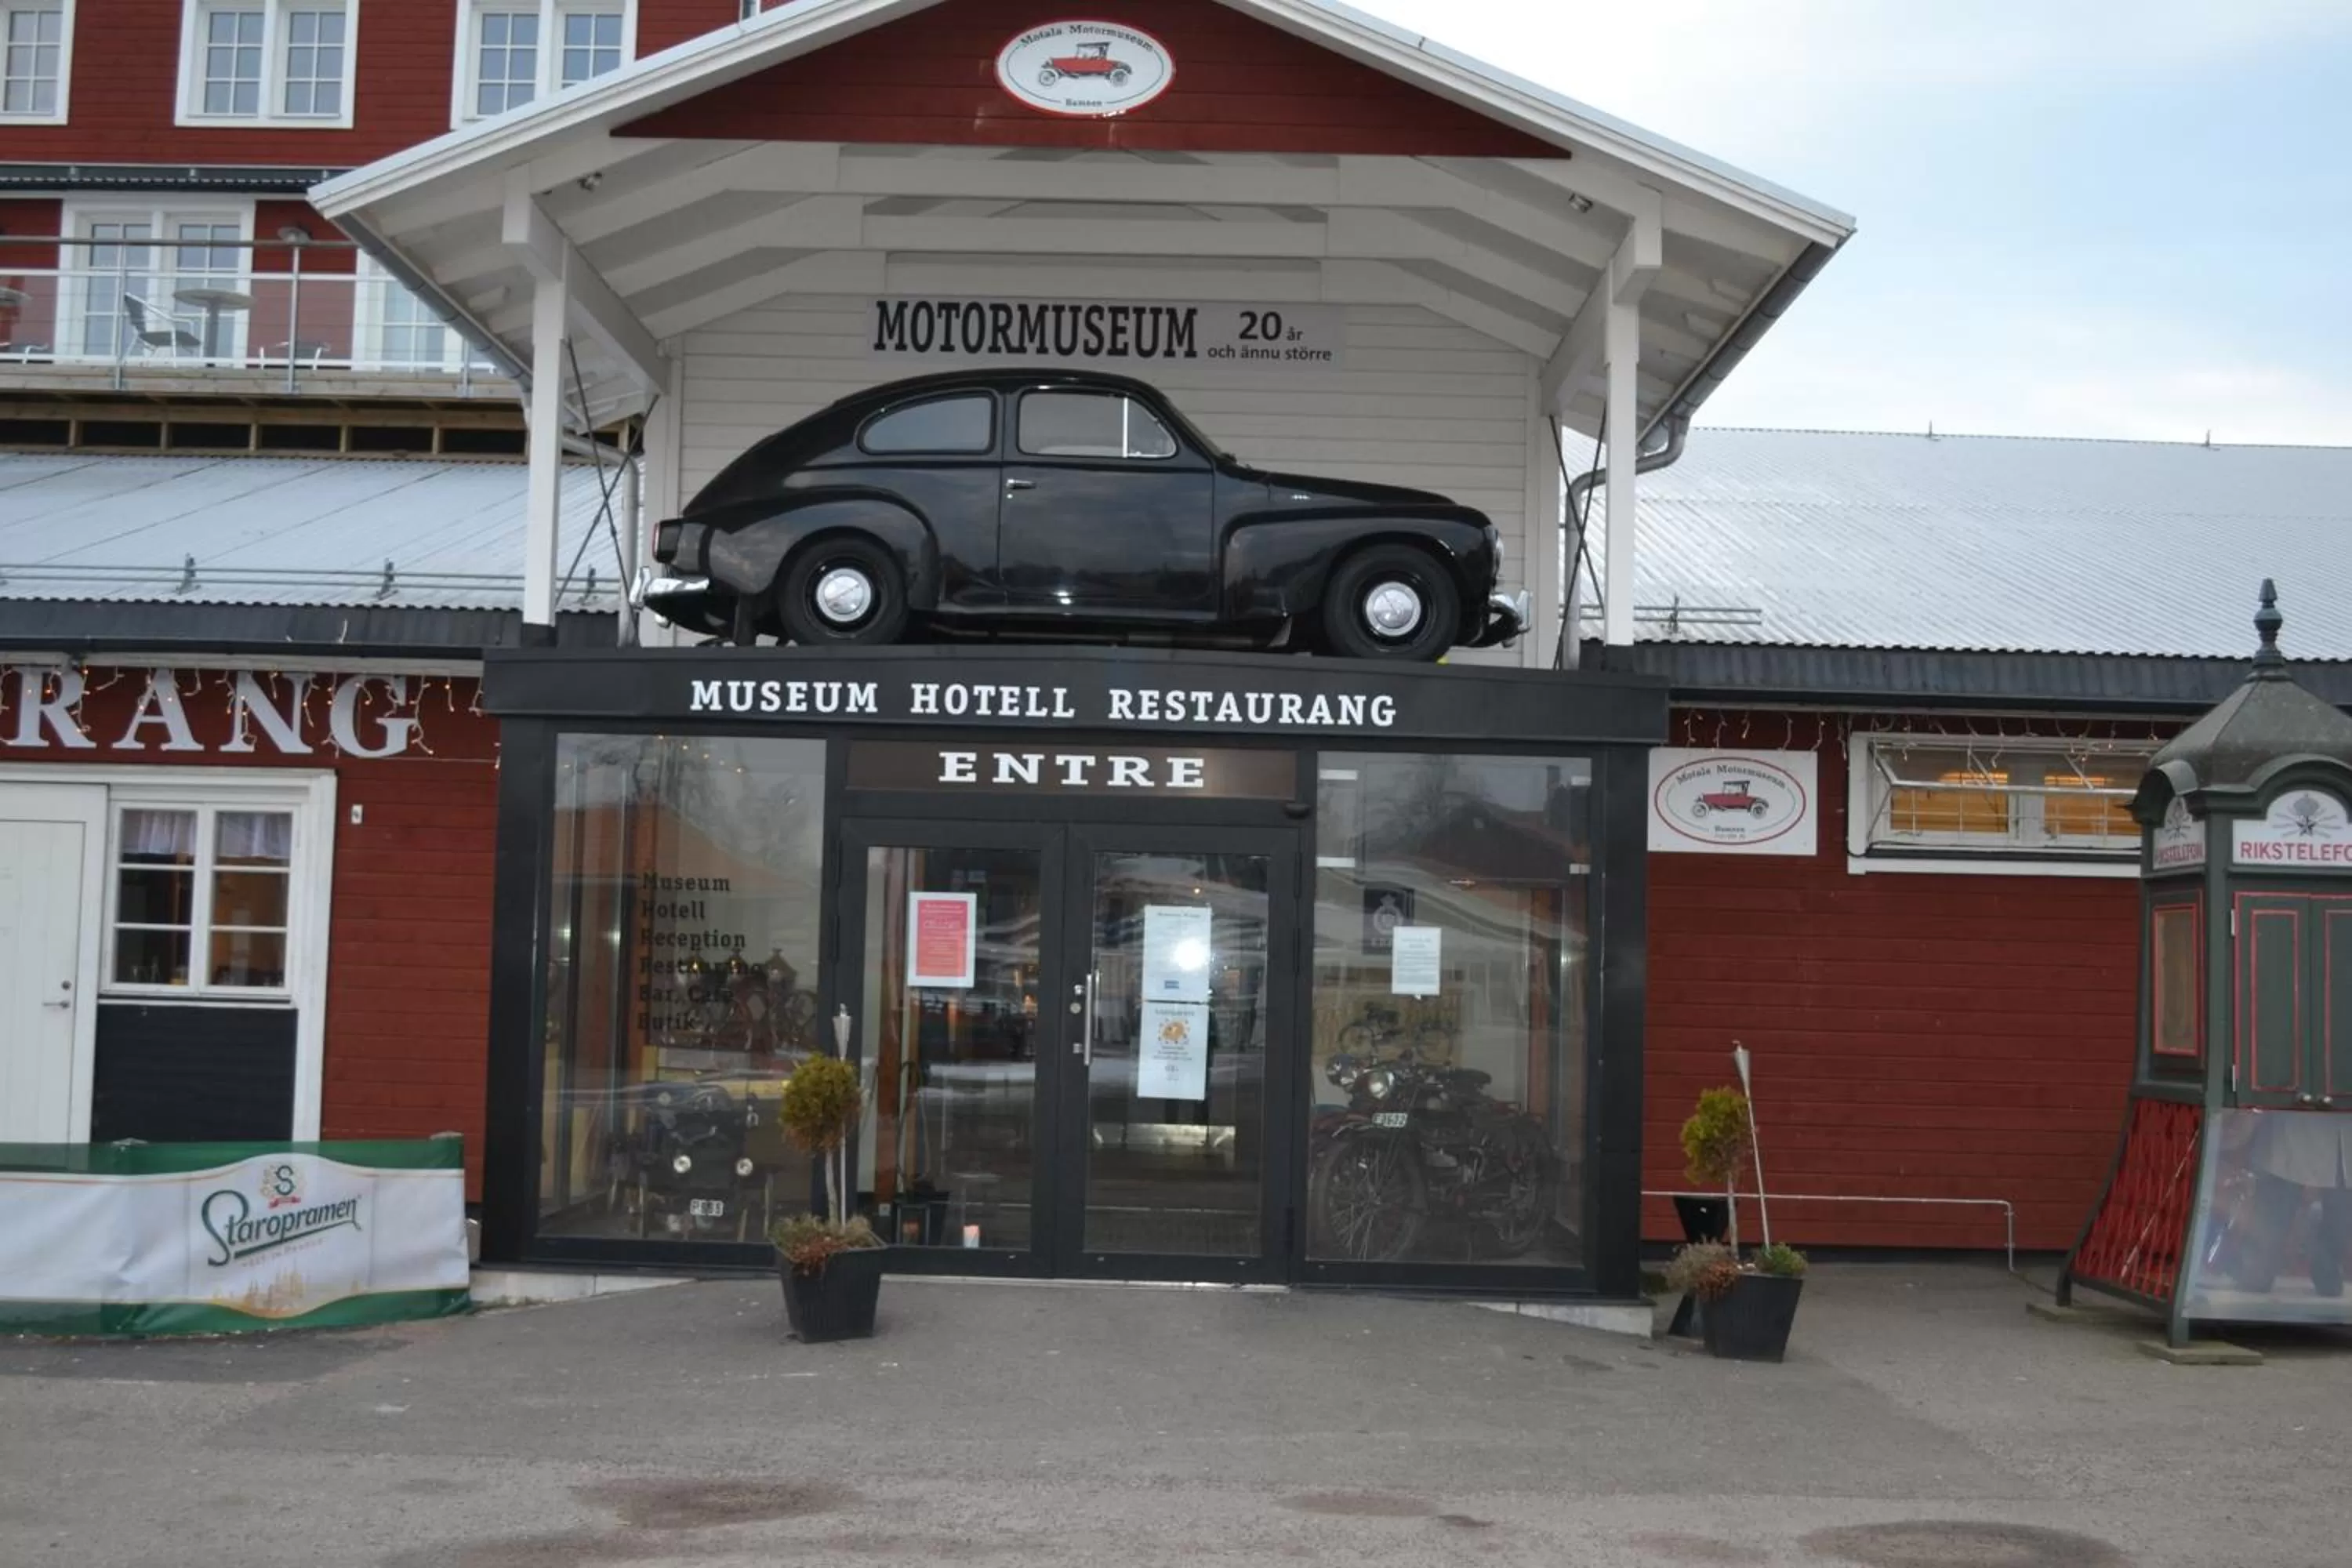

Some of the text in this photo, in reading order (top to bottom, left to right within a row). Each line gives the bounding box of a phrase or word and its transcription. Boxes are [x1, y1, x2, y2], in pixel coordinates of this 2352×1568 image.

[1019, 24, 1154, 52] Motala Motormuseum
[873, 300, 1198, 358] MOTORMUSEUM
[1239, 311, 1304, 342] 20 år
[1207, 345, 1332, 361] och ännu större
[0, 666, 418, 758] RANG
[690, 680, 1396, 727] MUSEUM HOTELL RESTAURANG
[938, 751, 1205, 789] ENTRE
[1676, 767, 1711, 785] Motala
[641, 872, 731, 891] Museum
[641, 899, 706, 920] Hotell
[640, 928, 746, 950] Reception
[201, 1189, 361, 1267] Staropramen
